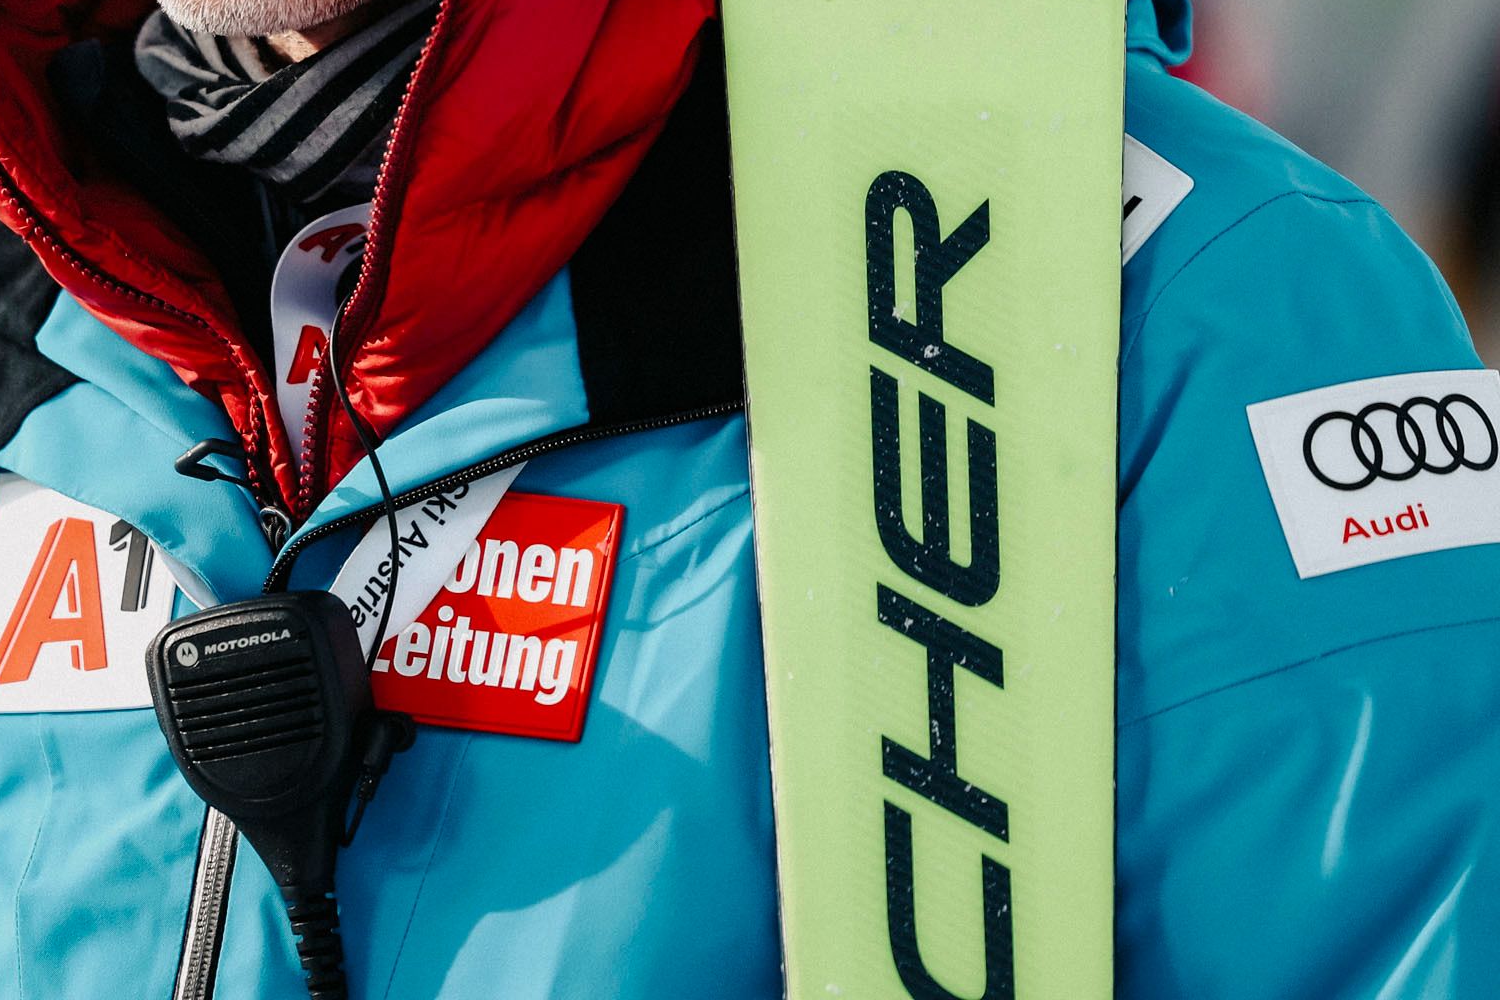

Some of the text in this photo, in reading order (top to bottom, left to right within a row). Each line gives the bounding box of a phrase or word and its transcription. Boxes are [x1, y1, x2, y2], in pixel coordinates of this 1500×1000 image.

[286, 324, 329, 385] A
[1342, 503, 1430, 544] Audi
[443, 537, 594, 608] onen
[865, 170, 1015, 1000] CHER
[204, 629, 291, 656] MOTOROLA
